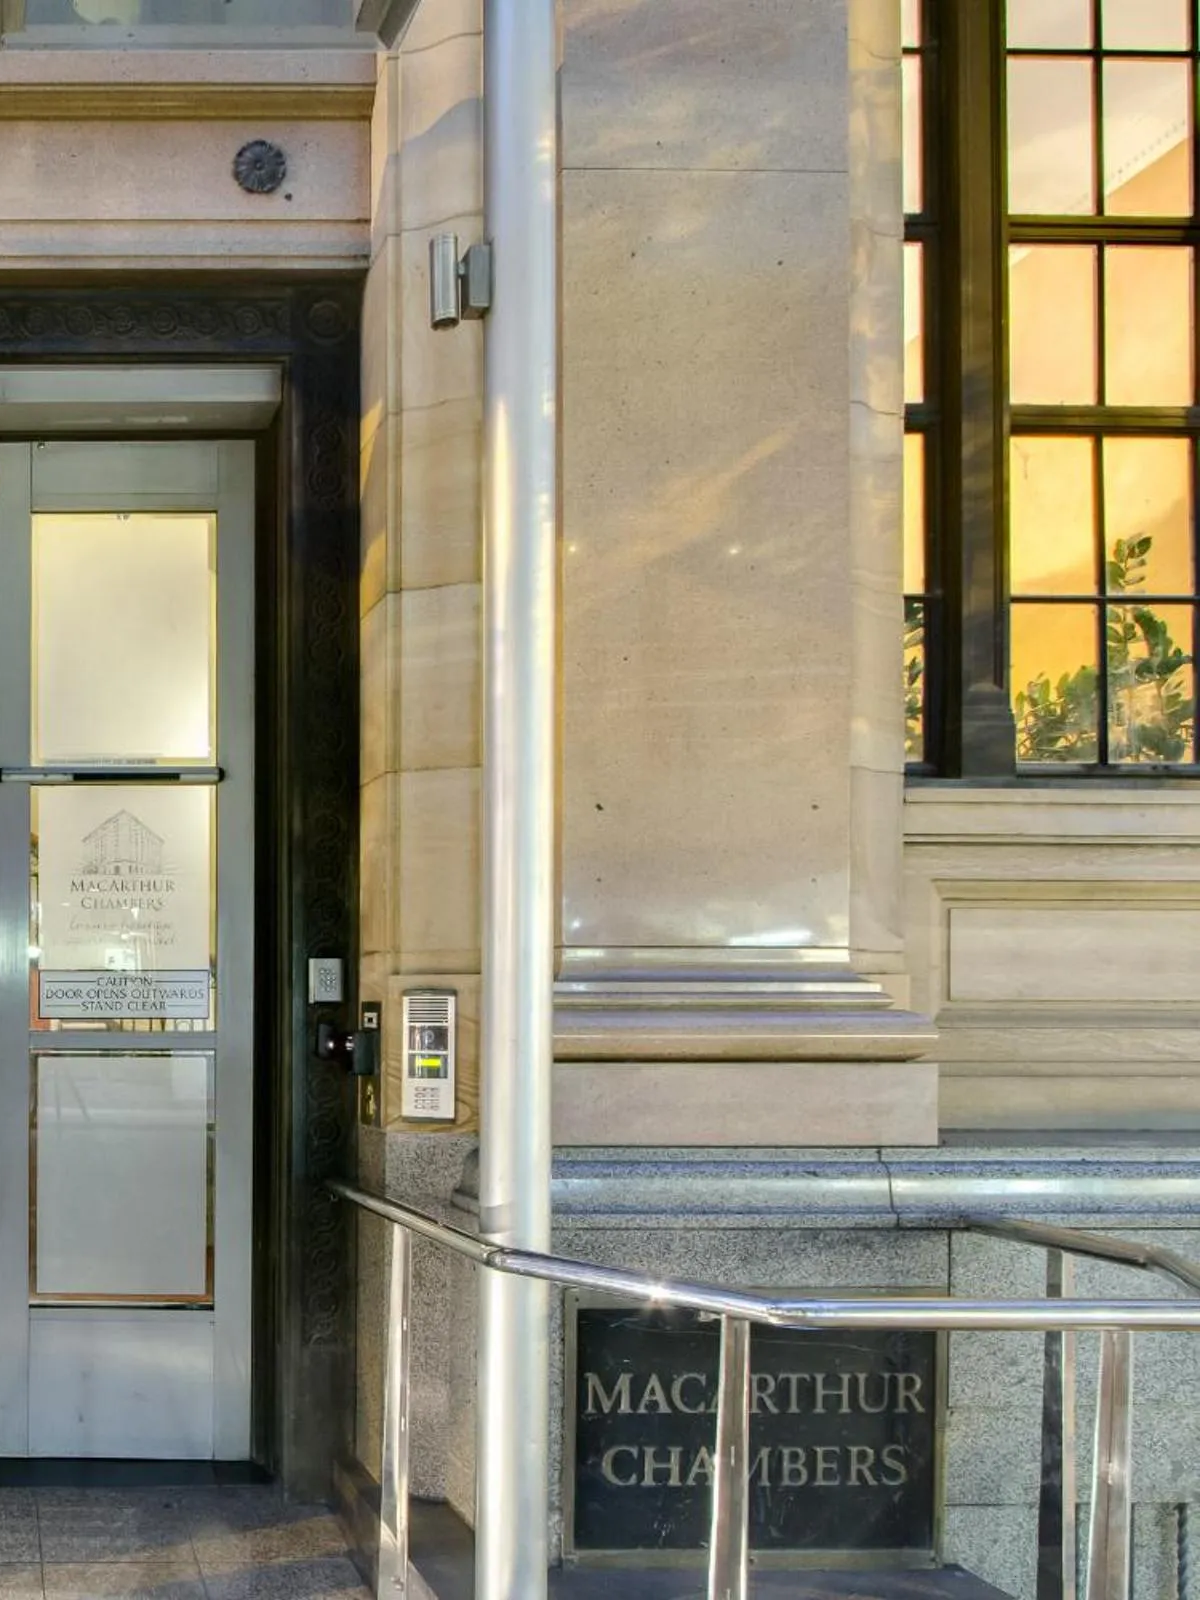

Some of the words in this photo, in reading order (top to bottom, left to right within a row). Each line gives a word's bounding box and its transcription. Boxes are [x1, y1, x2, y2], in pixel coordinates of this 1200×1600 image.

[70, 879, 176, 893] MACARTHUR
[80, 896, 166, 911] CHAMBERS
[45, 988, 83, 999] DOOR
[86, 988, 127, 999] OPENS
[130, 988, 204, 999] OUTWARDS
[80, 1001, 123, 1012] STAND
[127, 1001, 166, 1012] CLEAR
[583, 1372, 926, 1415] MACRTHUR
